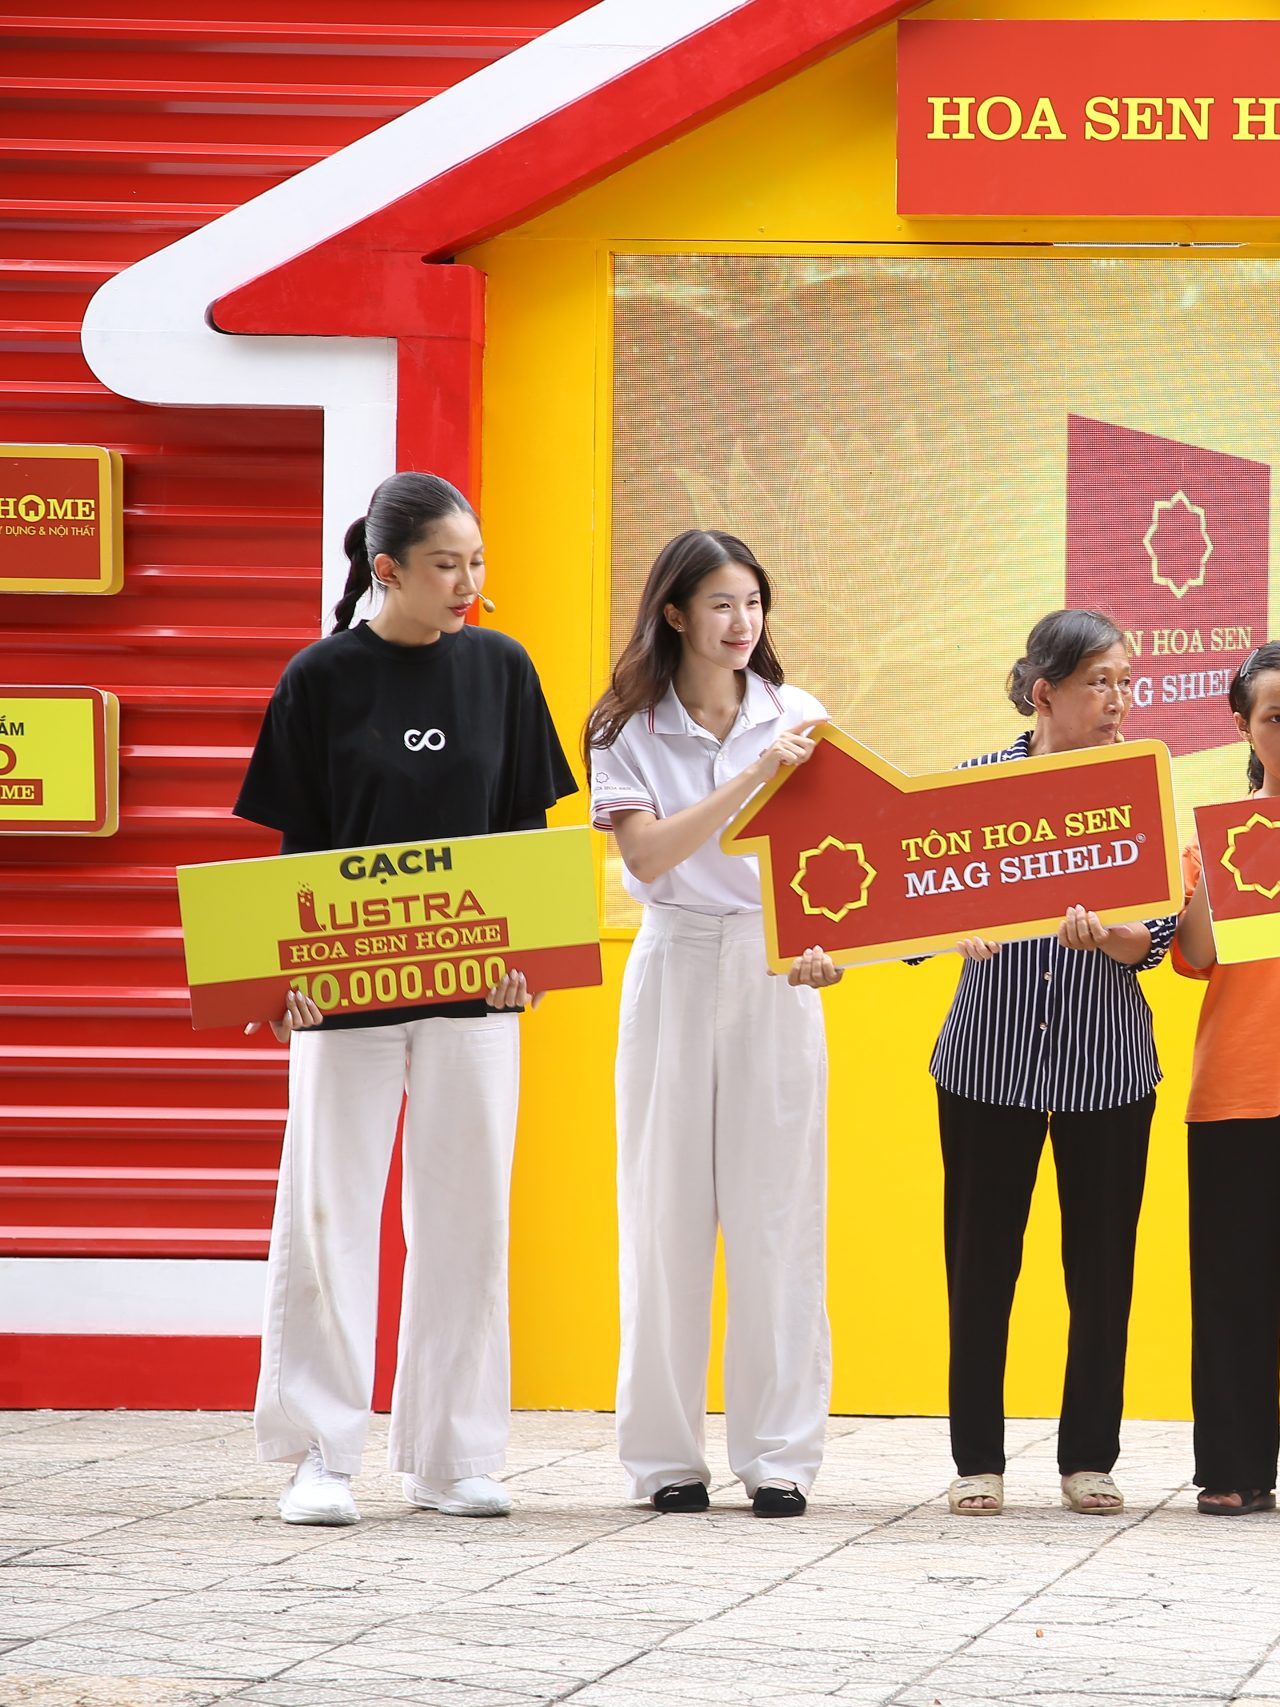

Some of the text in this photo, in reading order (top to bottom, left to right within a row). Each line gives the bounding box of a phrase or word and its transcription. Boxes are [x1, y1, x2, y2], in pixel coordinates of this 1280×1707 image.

[926, 95, 1067, 142] HOA
[1084, 95, 1215, 142] SEN
[39, 526, 46, 536] &
[1151, 628, 1205, 656] HOA
[1210, 626, 1253, 652] SEN
[1161, 668, 1233, 703] SHIEL
[901, 804, 1132, 862] TÔN HOA SEN
[339, 846, 453, 885] GẠCH
[904, 861, 991, 899] MAG
[297, 882, 487, 934] LUSTRA
[289, 924, 501, 963] HOA SEN HOME
